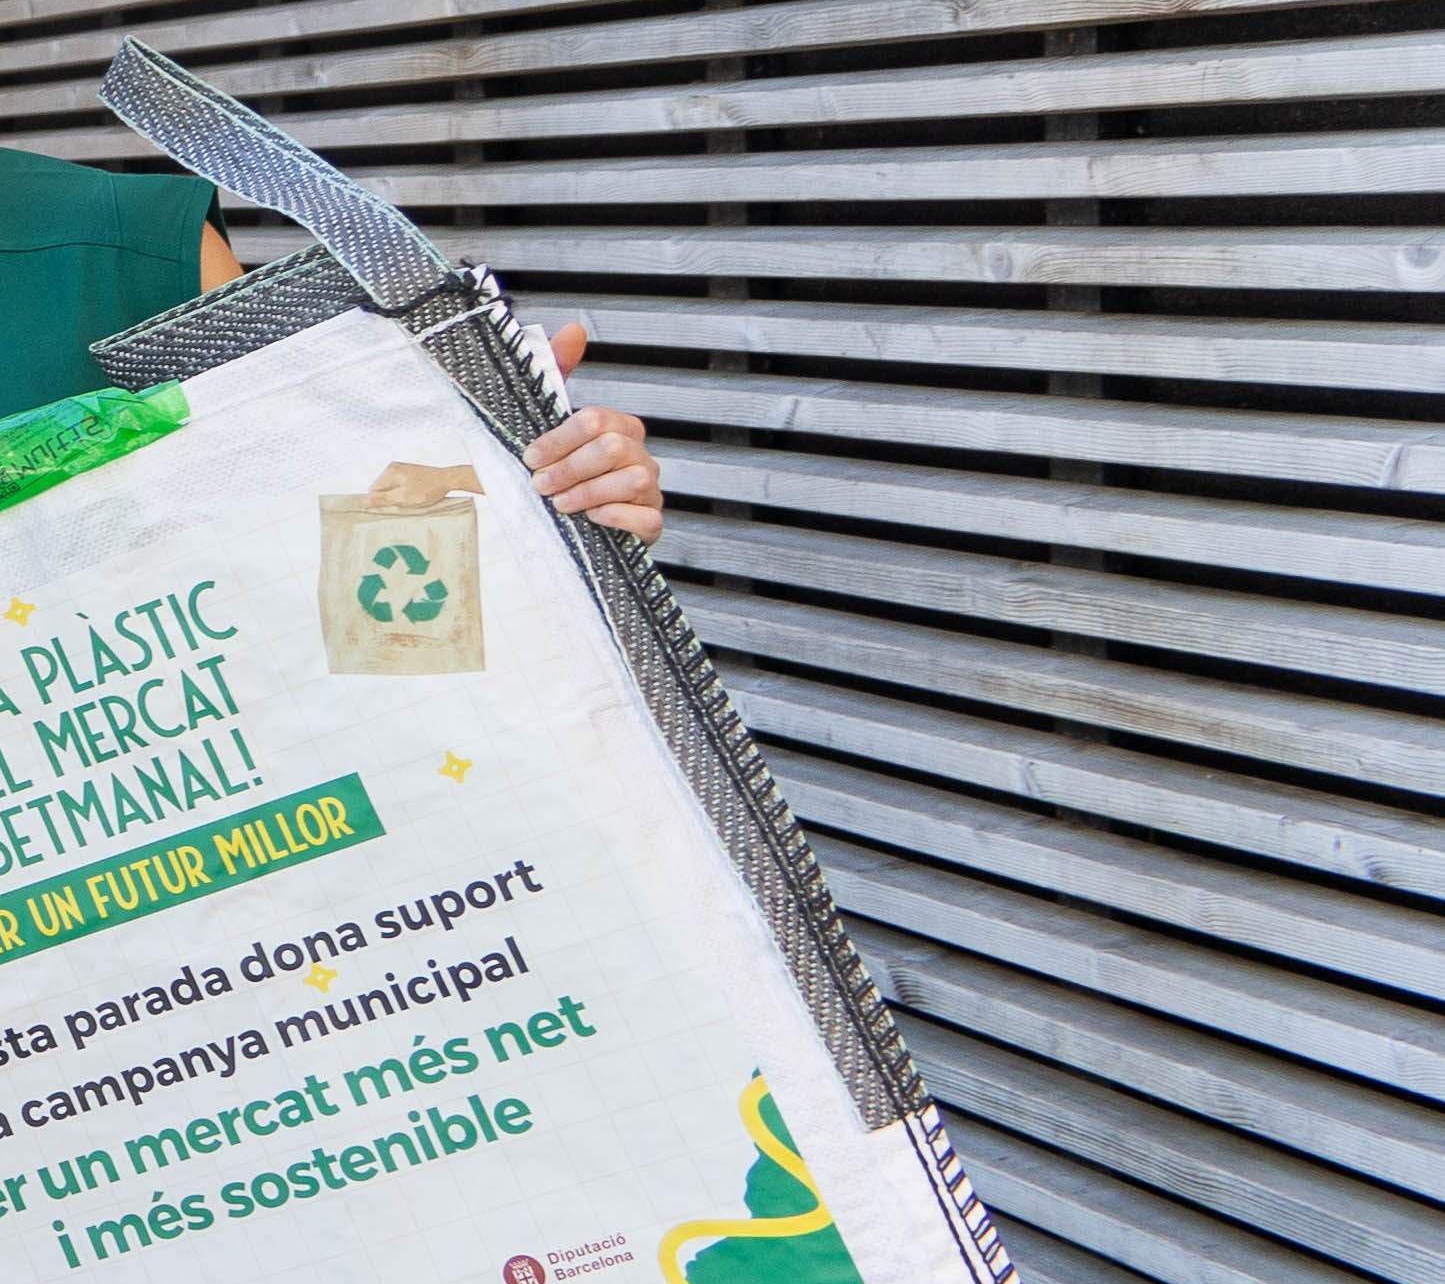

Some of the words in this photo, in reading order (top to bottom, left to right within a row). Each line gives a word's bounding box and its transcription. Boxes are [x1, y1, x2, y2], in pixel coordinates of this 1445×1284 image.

[20, 579, 240, 705] PLÀSTIC
[34, 653, 240, 777] MERCAT
[26, 885, 86, 937] UN
[84, 845, 214, 919] FUTUR
[212, 795, 356, 875] MILLOR
[64, 965, 234, 1051] parada
[240, 921, 368, 985] dona
[374, 859, 544, 939] suport
[20, 1027, 270, 1127] campanya
[274, 935, 530, 1049] municipal
[36, 1147, 120, 1201] un
[124, 1075, 342, 1175] mercat
[344, 1035, 480, 1107] més
[484, 995, 598, 1063] net
[52, 1219, 82, 1269] i
[84, 1191, 214, 1261] més
[220, 1093, 534, 1219] sostenible
[546, 1233, 628, 1267] Diputació
[554, 1249, 636, 1283] Barcelona
